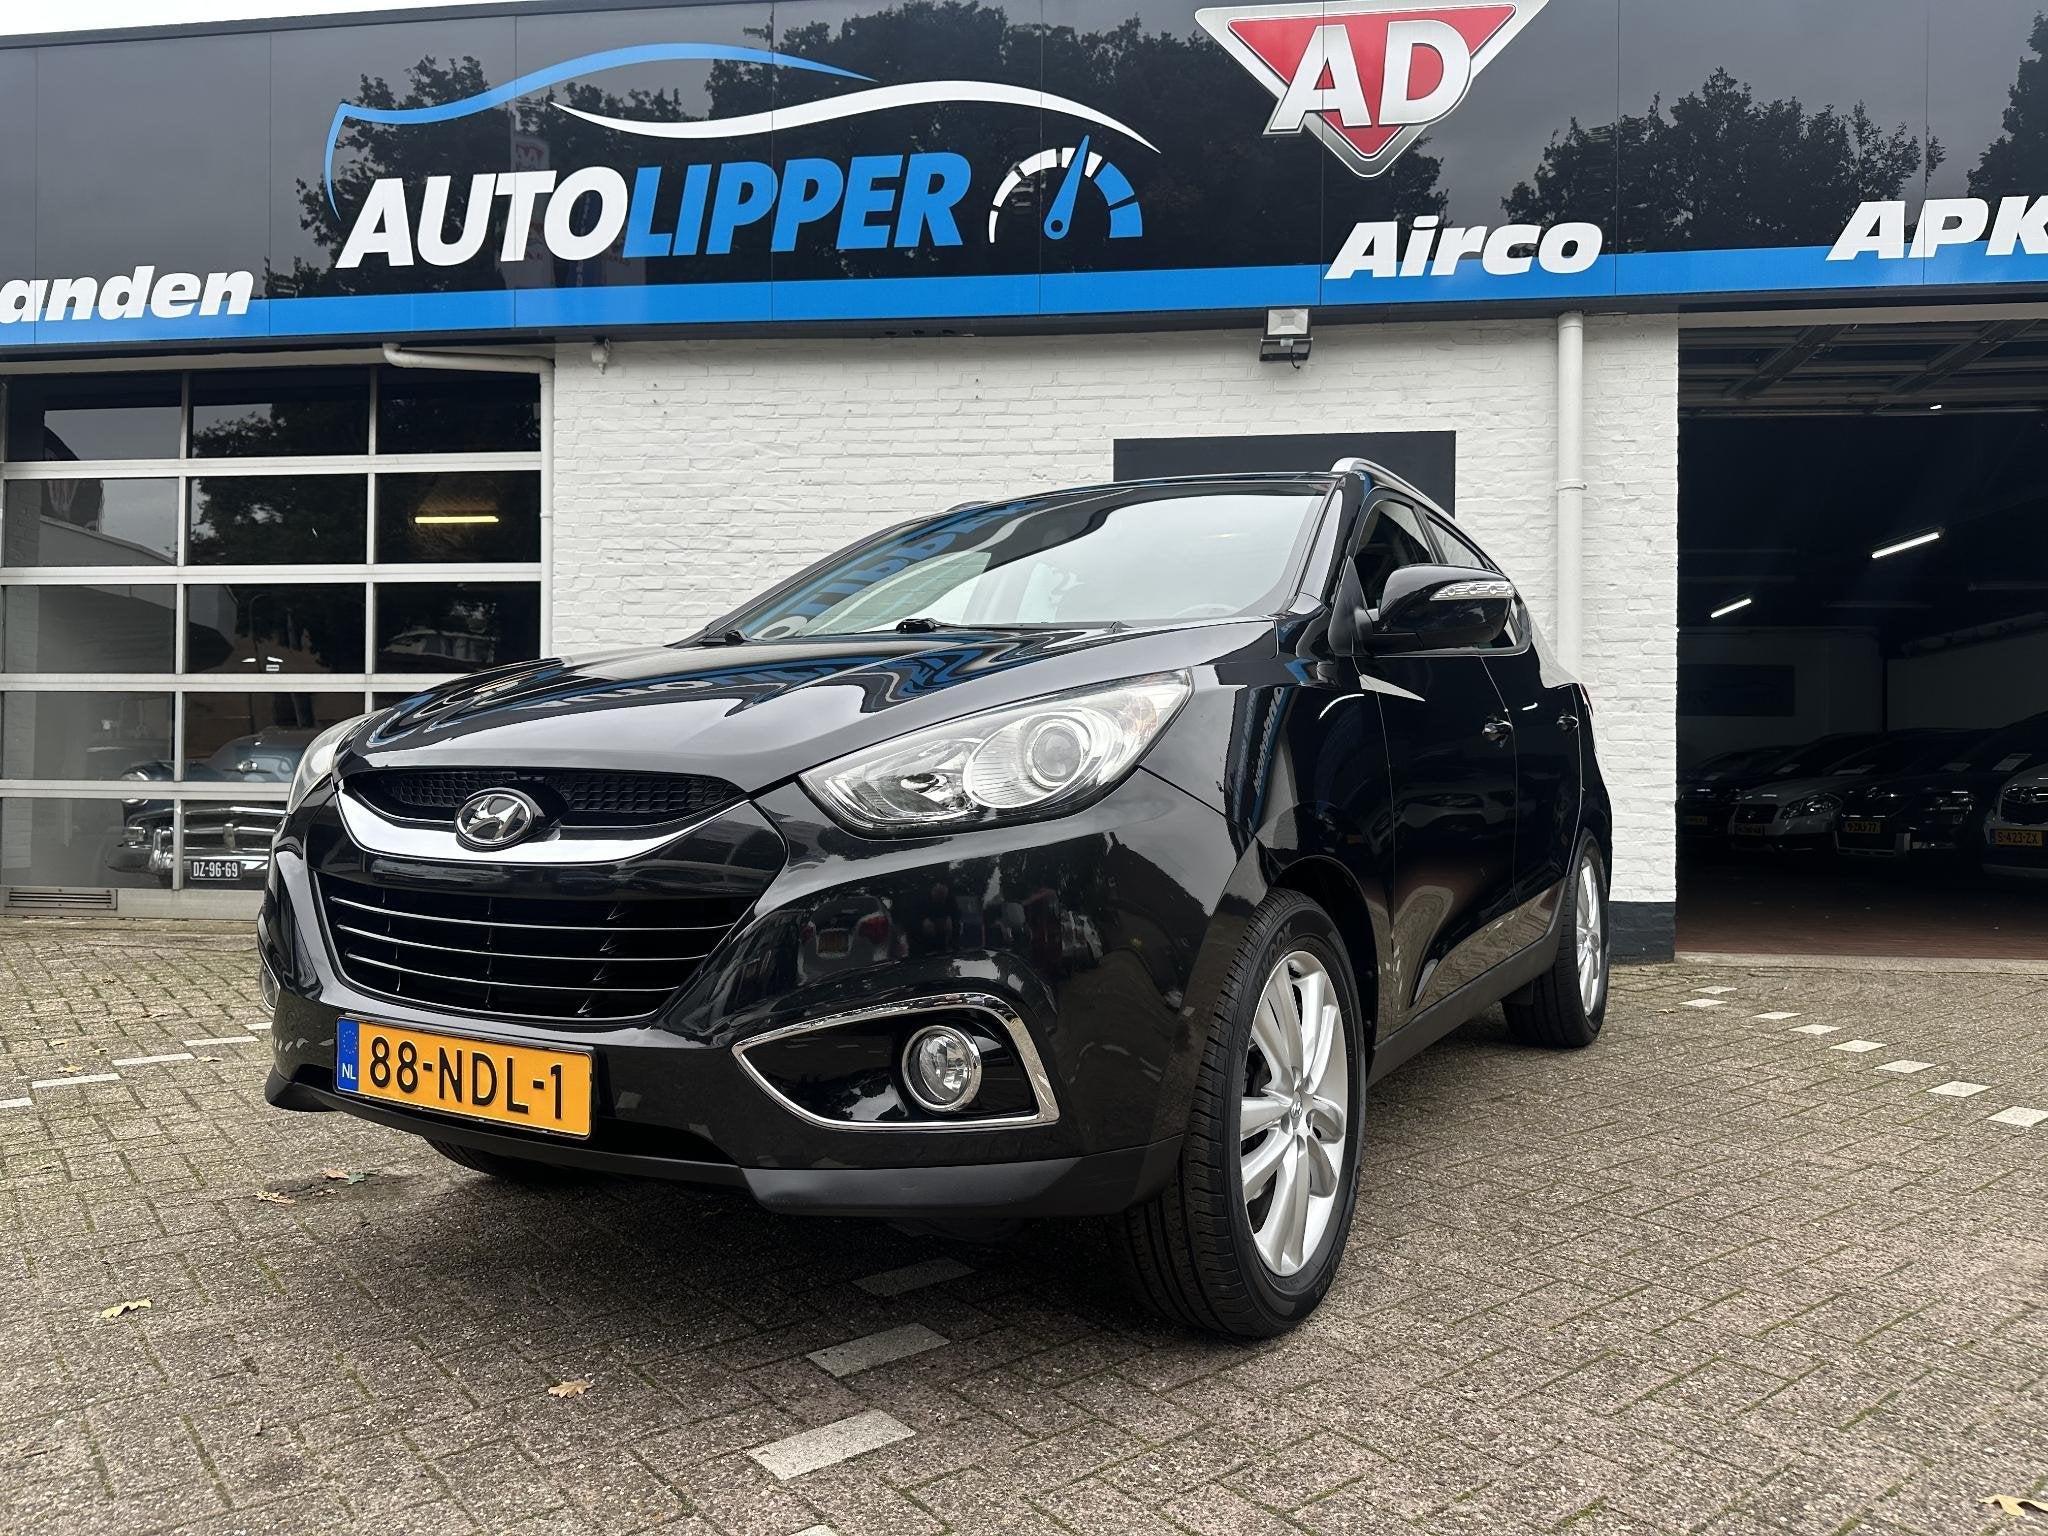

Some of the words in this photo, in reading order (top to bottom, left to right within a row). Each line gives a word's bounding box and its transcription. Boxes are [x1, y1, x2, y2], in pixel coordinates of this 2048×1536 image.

[1268, 19, 1471, 132] AD
[335, 152, 972, 269] AUTOLIPPER
[1825, 195, 2048, 261] APK
[1324, 215, 1603, 281] Airco
[0, 265, 254, 324] anden
[193, 861, 238, 878] DZ-96-69
[341, 1062, 357, 1081] NL
[369, 1036, 562, 1121] 88-NDL-1
